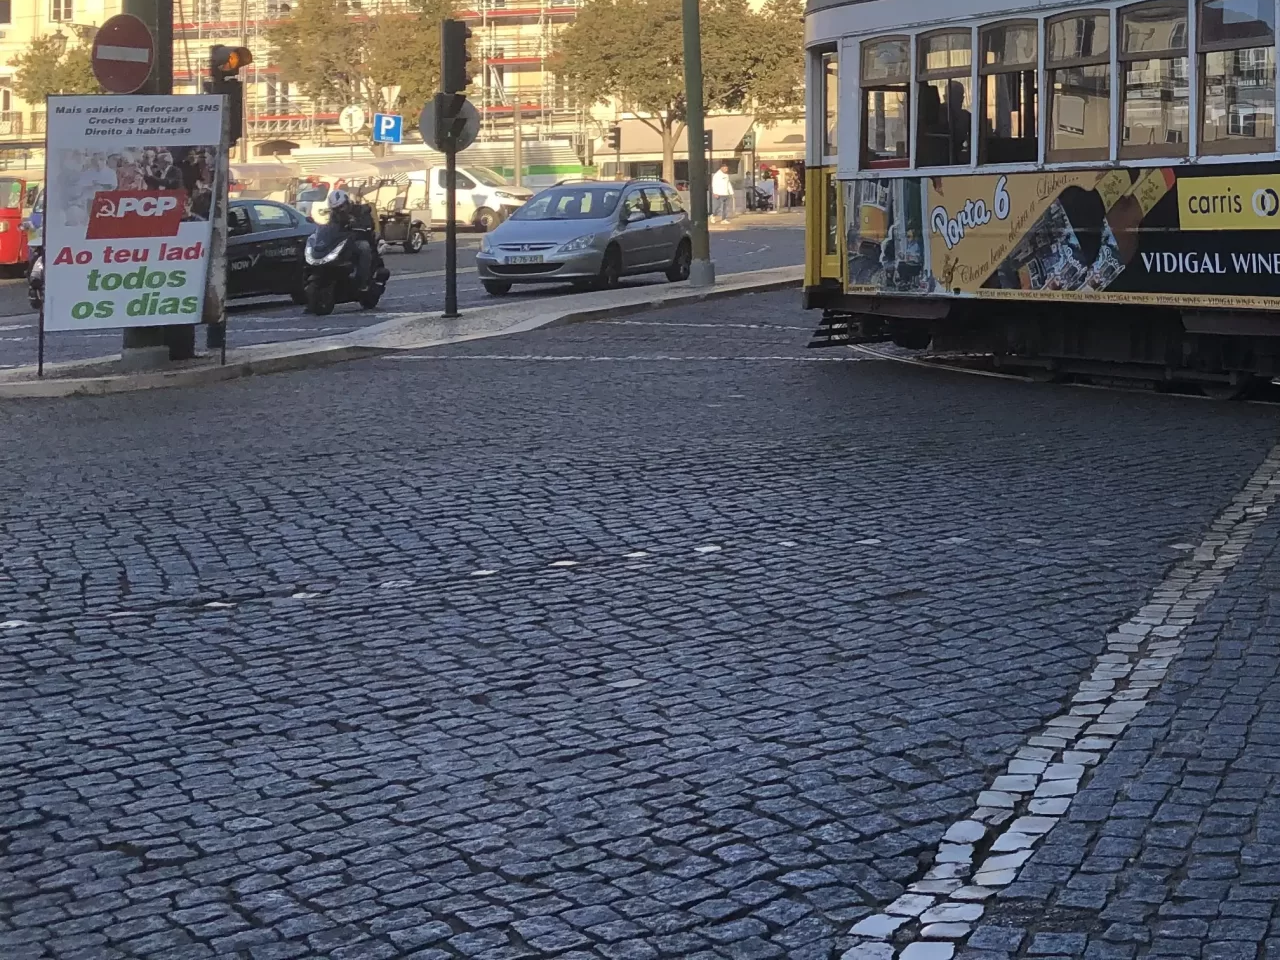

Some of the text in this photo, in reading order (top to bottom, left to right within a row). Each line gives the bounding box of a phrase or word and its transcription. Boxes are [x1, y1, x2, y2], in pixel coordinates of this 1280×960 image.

[55, 105, 82, 114] Mais
[85, 105, 124, 114] salário
[135, 104, 183, 114] Reforçar
[196, 104, 220, 112] SNS
[84, 126, 191, 136] Direito à habitação
[88, 115, 188, 126] Creches gratuitas
[380, 116, 396, 135] P
[116, 196, 178, 218] PCP
[1188, 187, 1242, 214] carris
[930, 174, 1011, 251] Porta 6
[53, 241, 205, 266] Ao teu lad
[1140, 251, 1227, 274] VIDIGAL
[231, 260, 249, 271] NOW
[87, 265, 187, 291] todos
[71, 291, 198, 320] os dias
